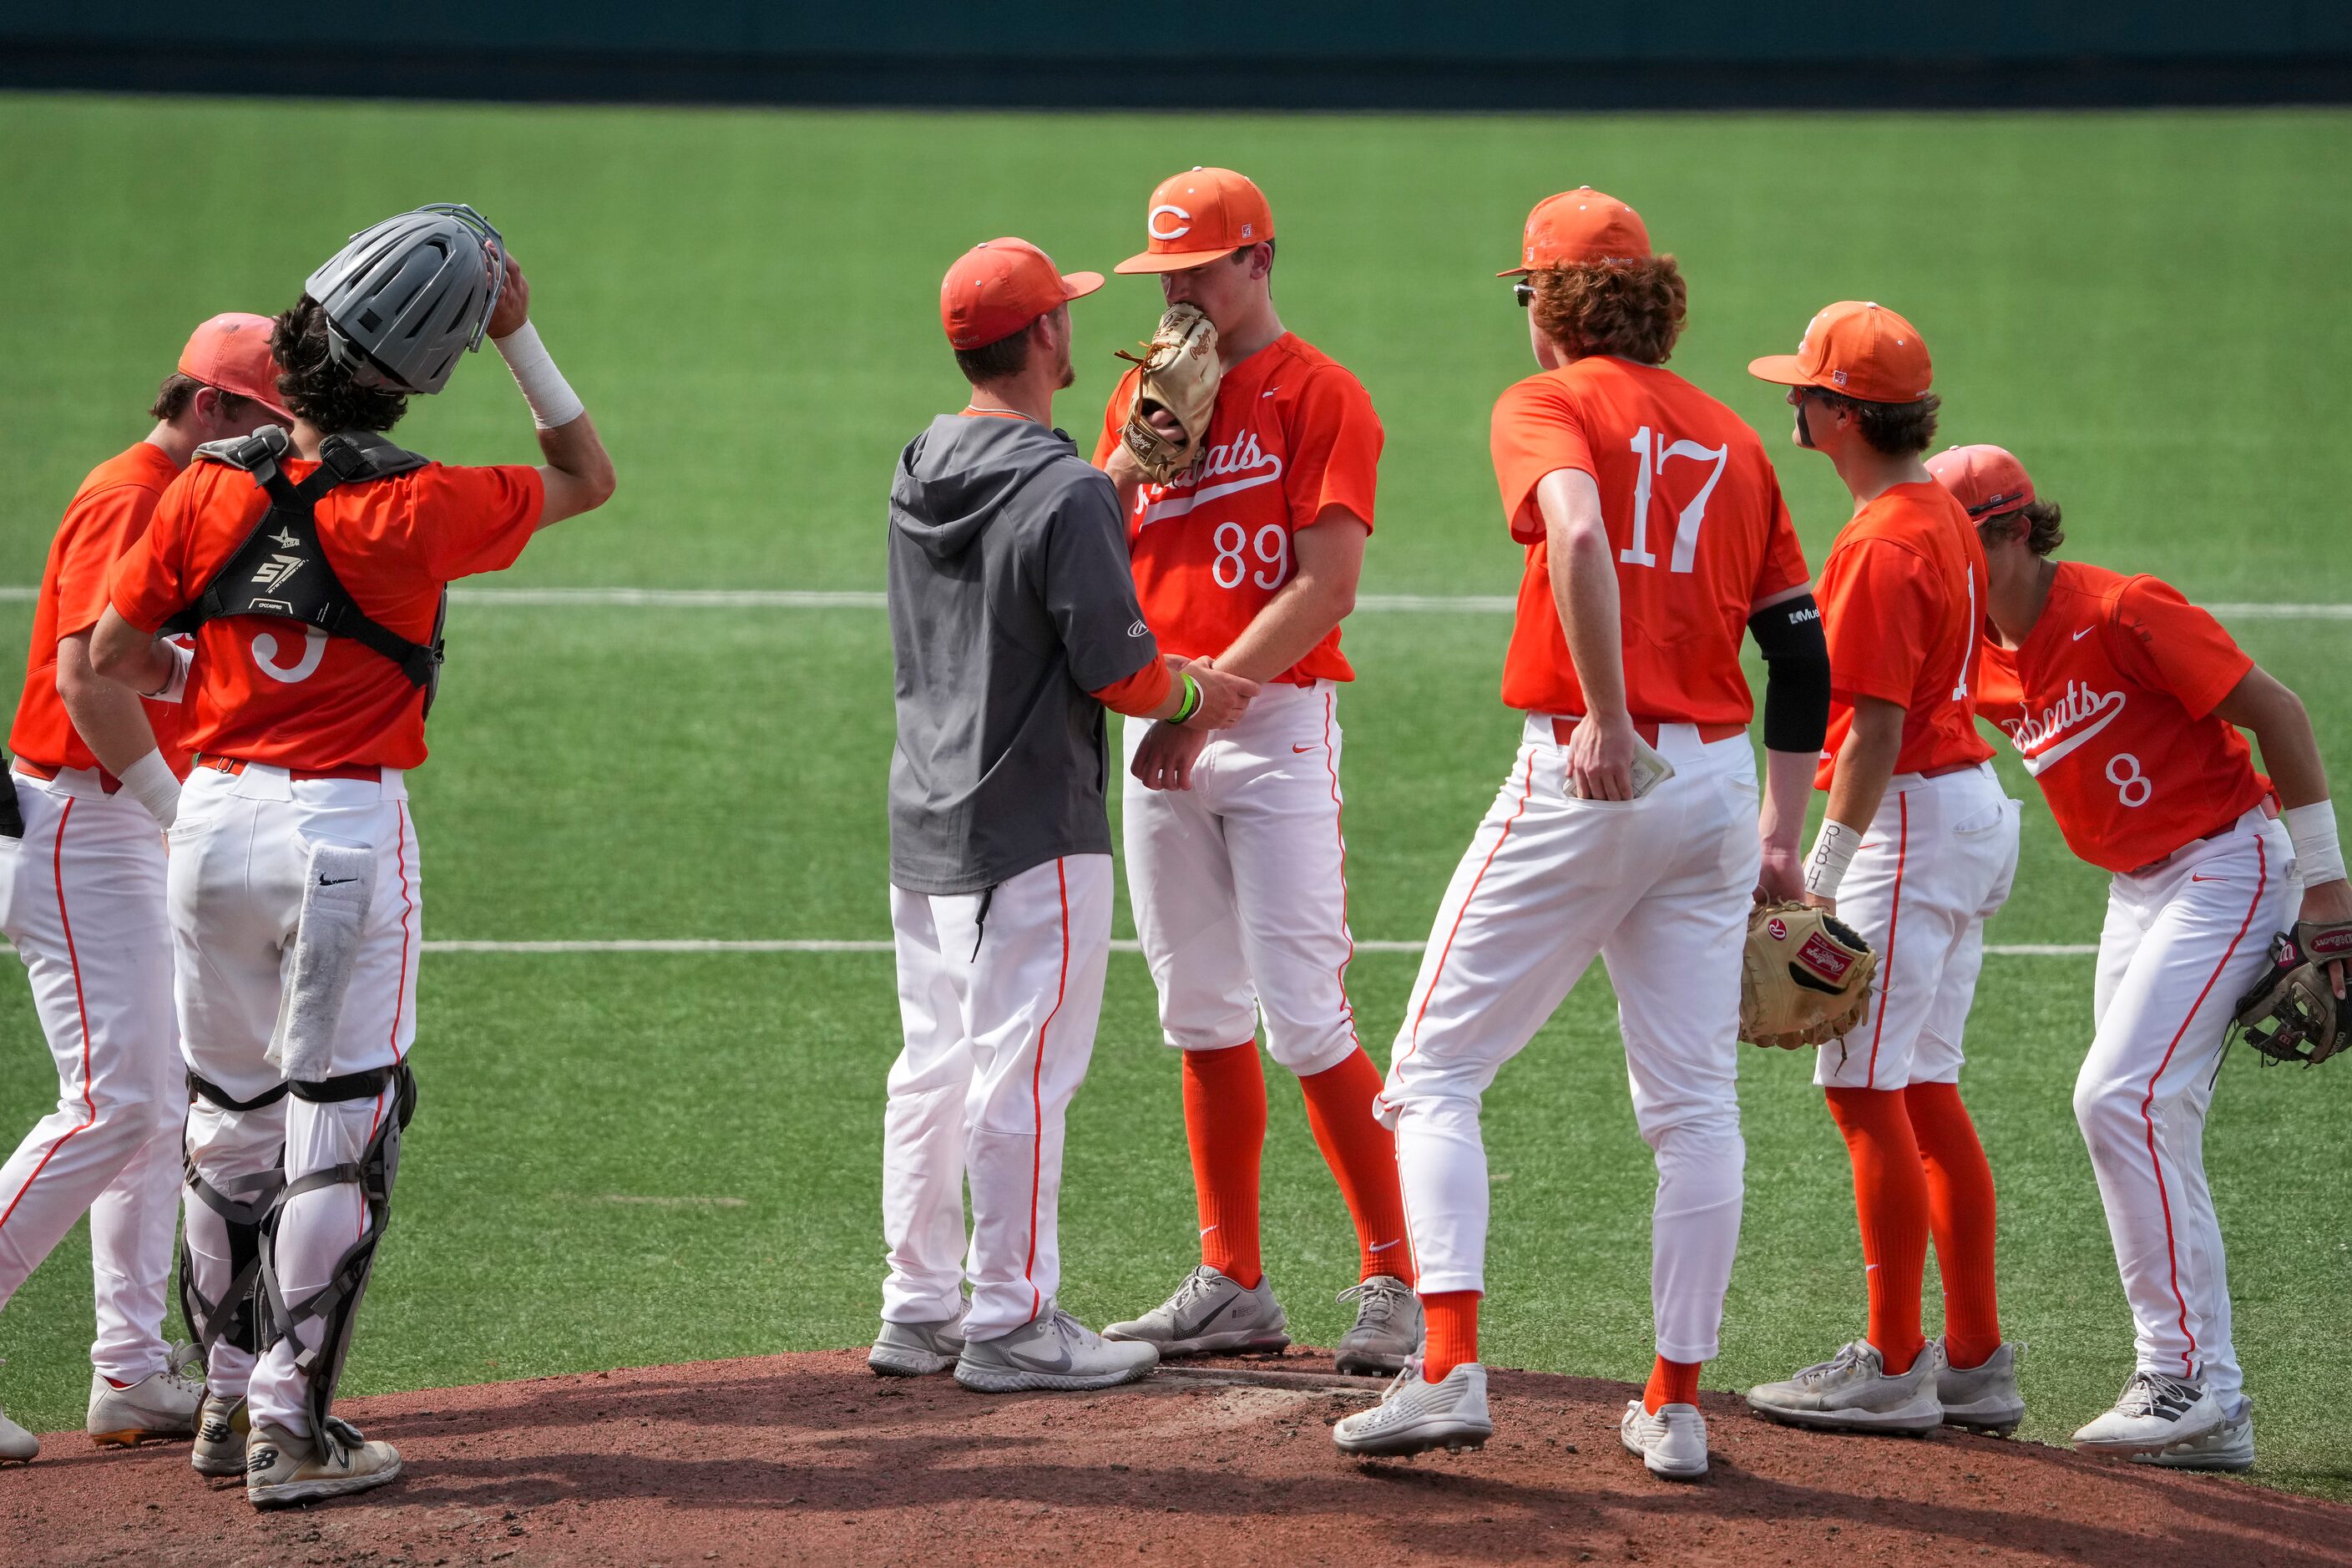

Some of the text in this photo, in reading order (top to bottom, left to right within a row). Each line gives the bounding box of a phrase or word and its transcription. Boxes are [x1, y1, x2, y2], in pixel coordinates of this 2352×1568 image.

[1127, 424, 1152, 449] Rawlings
[1620, 425, 1727, 574] 17
[1212, 521, 1287, 590] 89
[2106, 752, 2152, 807] 8
